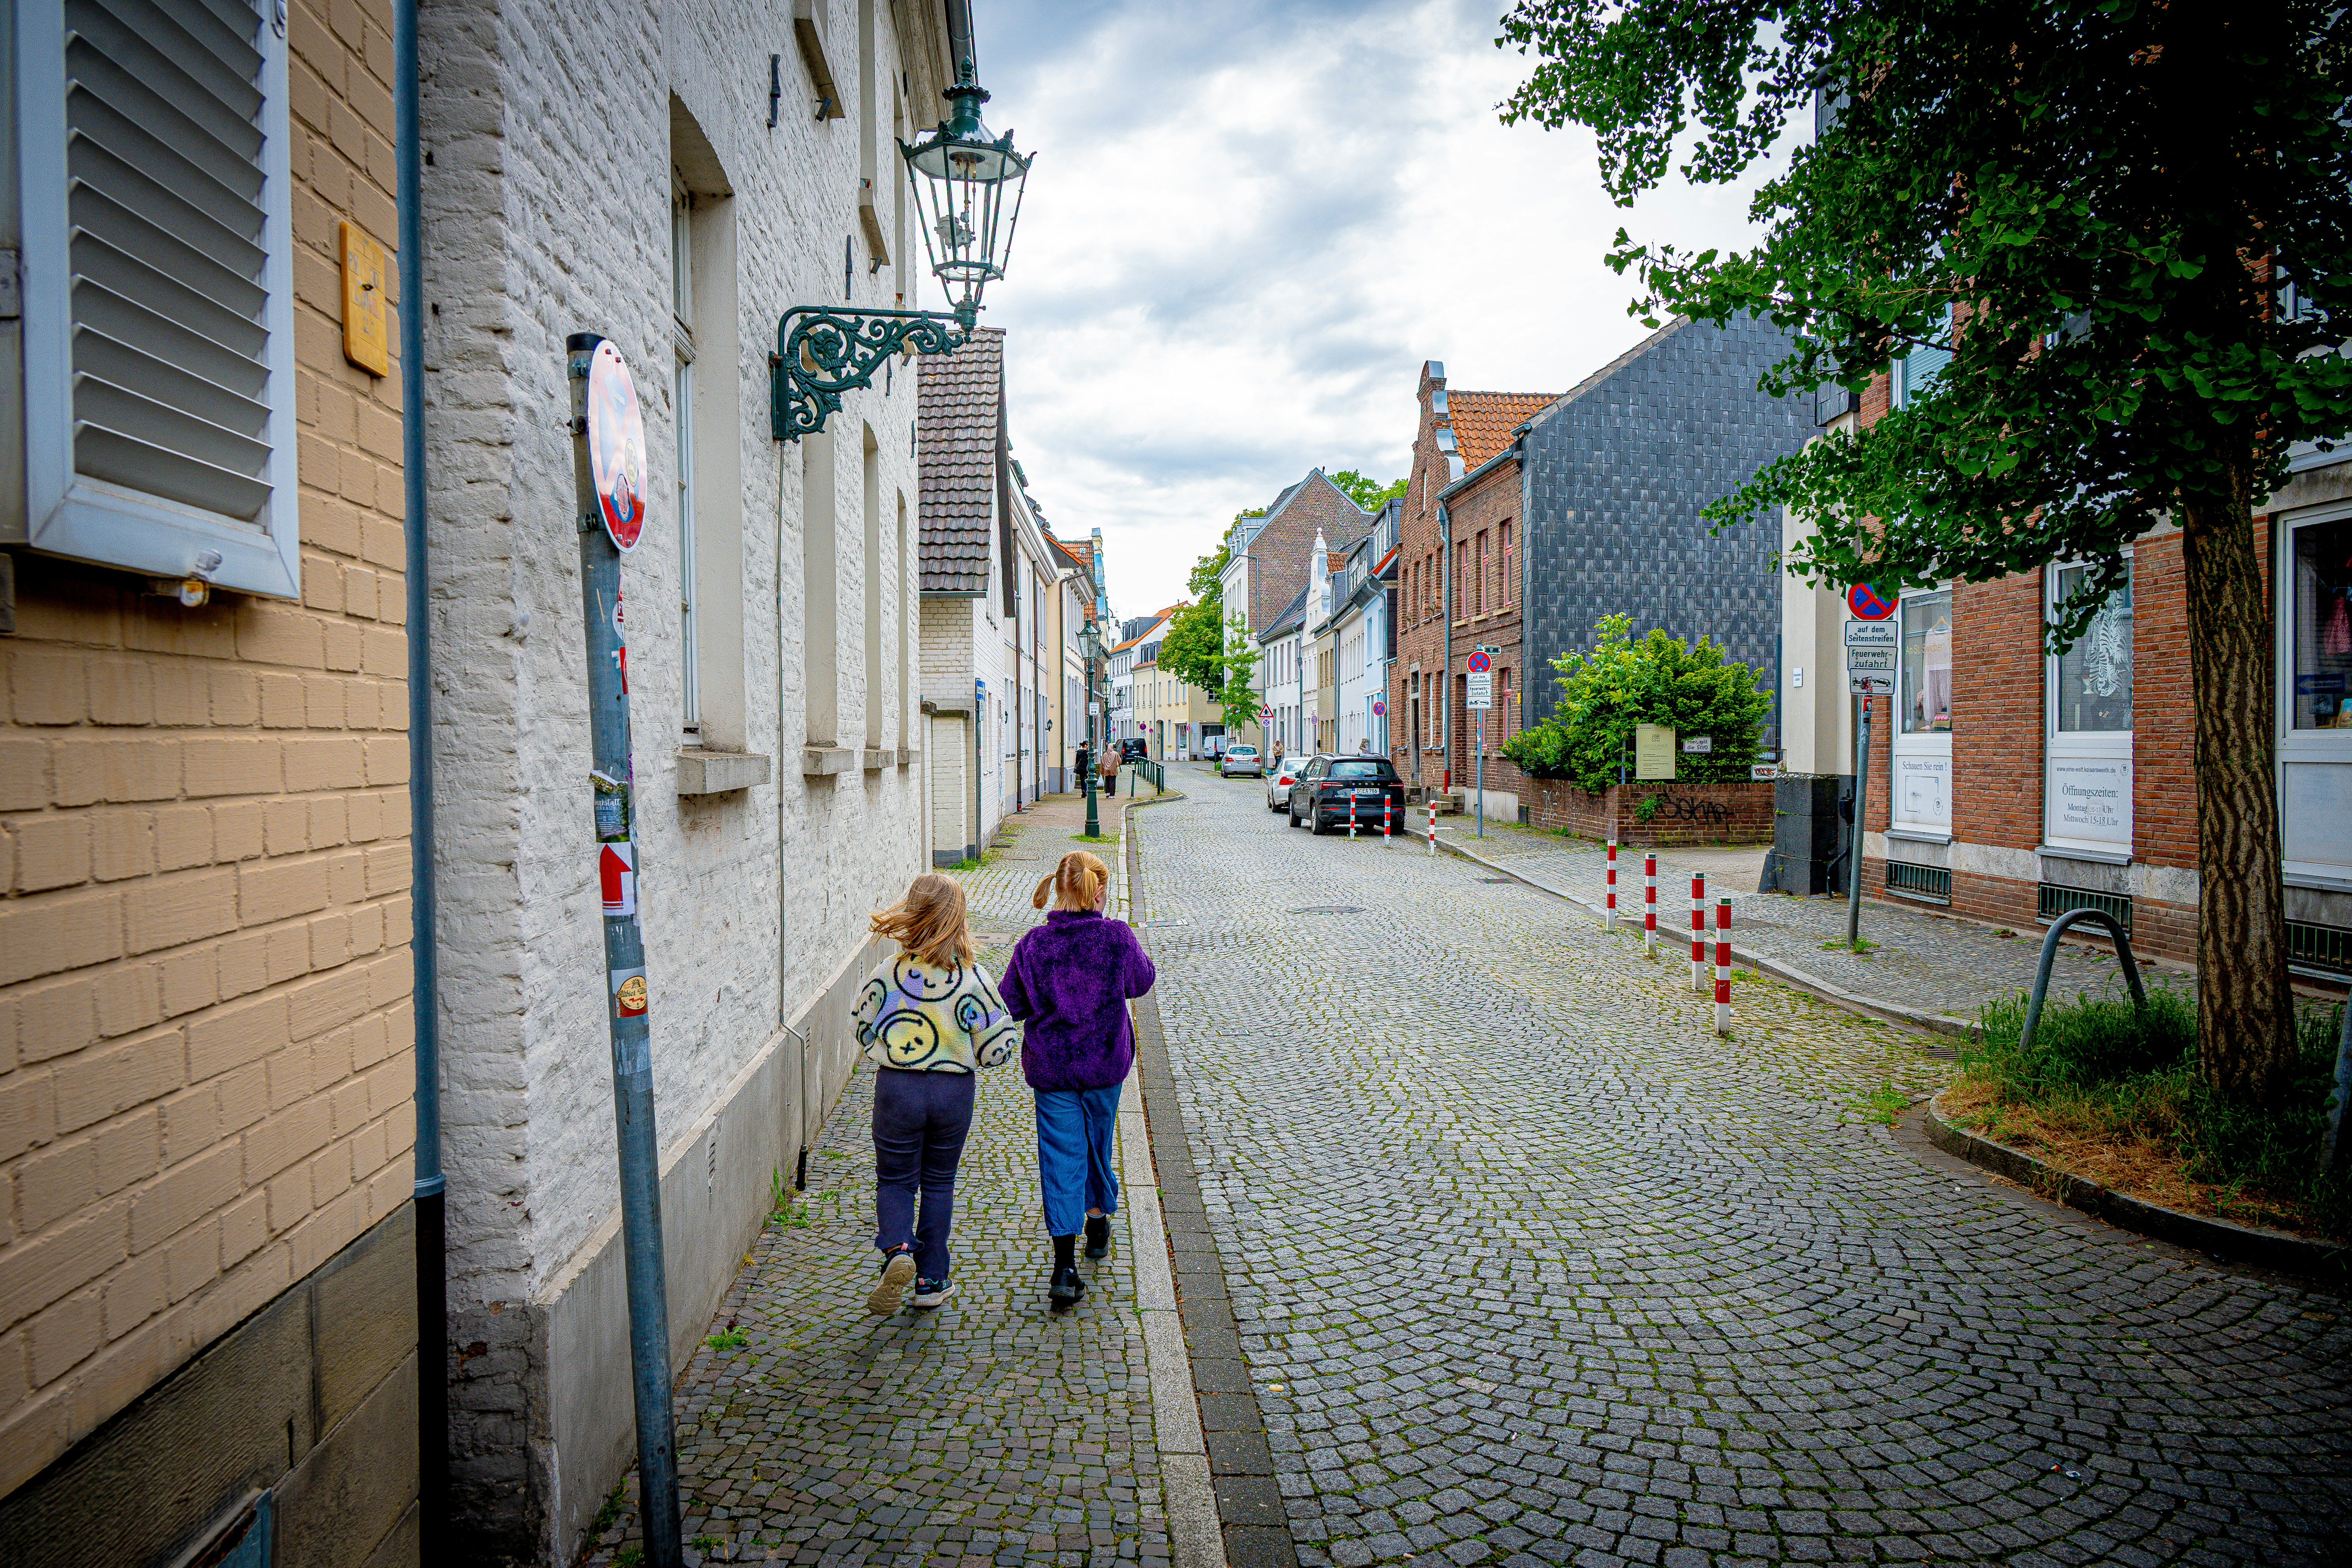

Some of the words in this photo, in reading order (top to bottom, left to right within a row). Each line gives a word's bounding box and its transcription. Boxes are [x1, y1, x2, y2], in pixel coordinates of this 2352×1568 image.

[1906, 645, 1913, 654] An
[1903, 761, 1922, 770] Schauen
[1933, 762, 1943, 771] rein
[2062, 783, 2118, 799] Öffnungszeiten:
[2068, 803, 2088, 814] Montag
[2103, 805, 2114, 813] Uhr
[2063, 814, 2088, 823] Mittwoch
[2090, 816, 2105, 825] 15-18
[2107, 817, 2118, 825] Uhr
